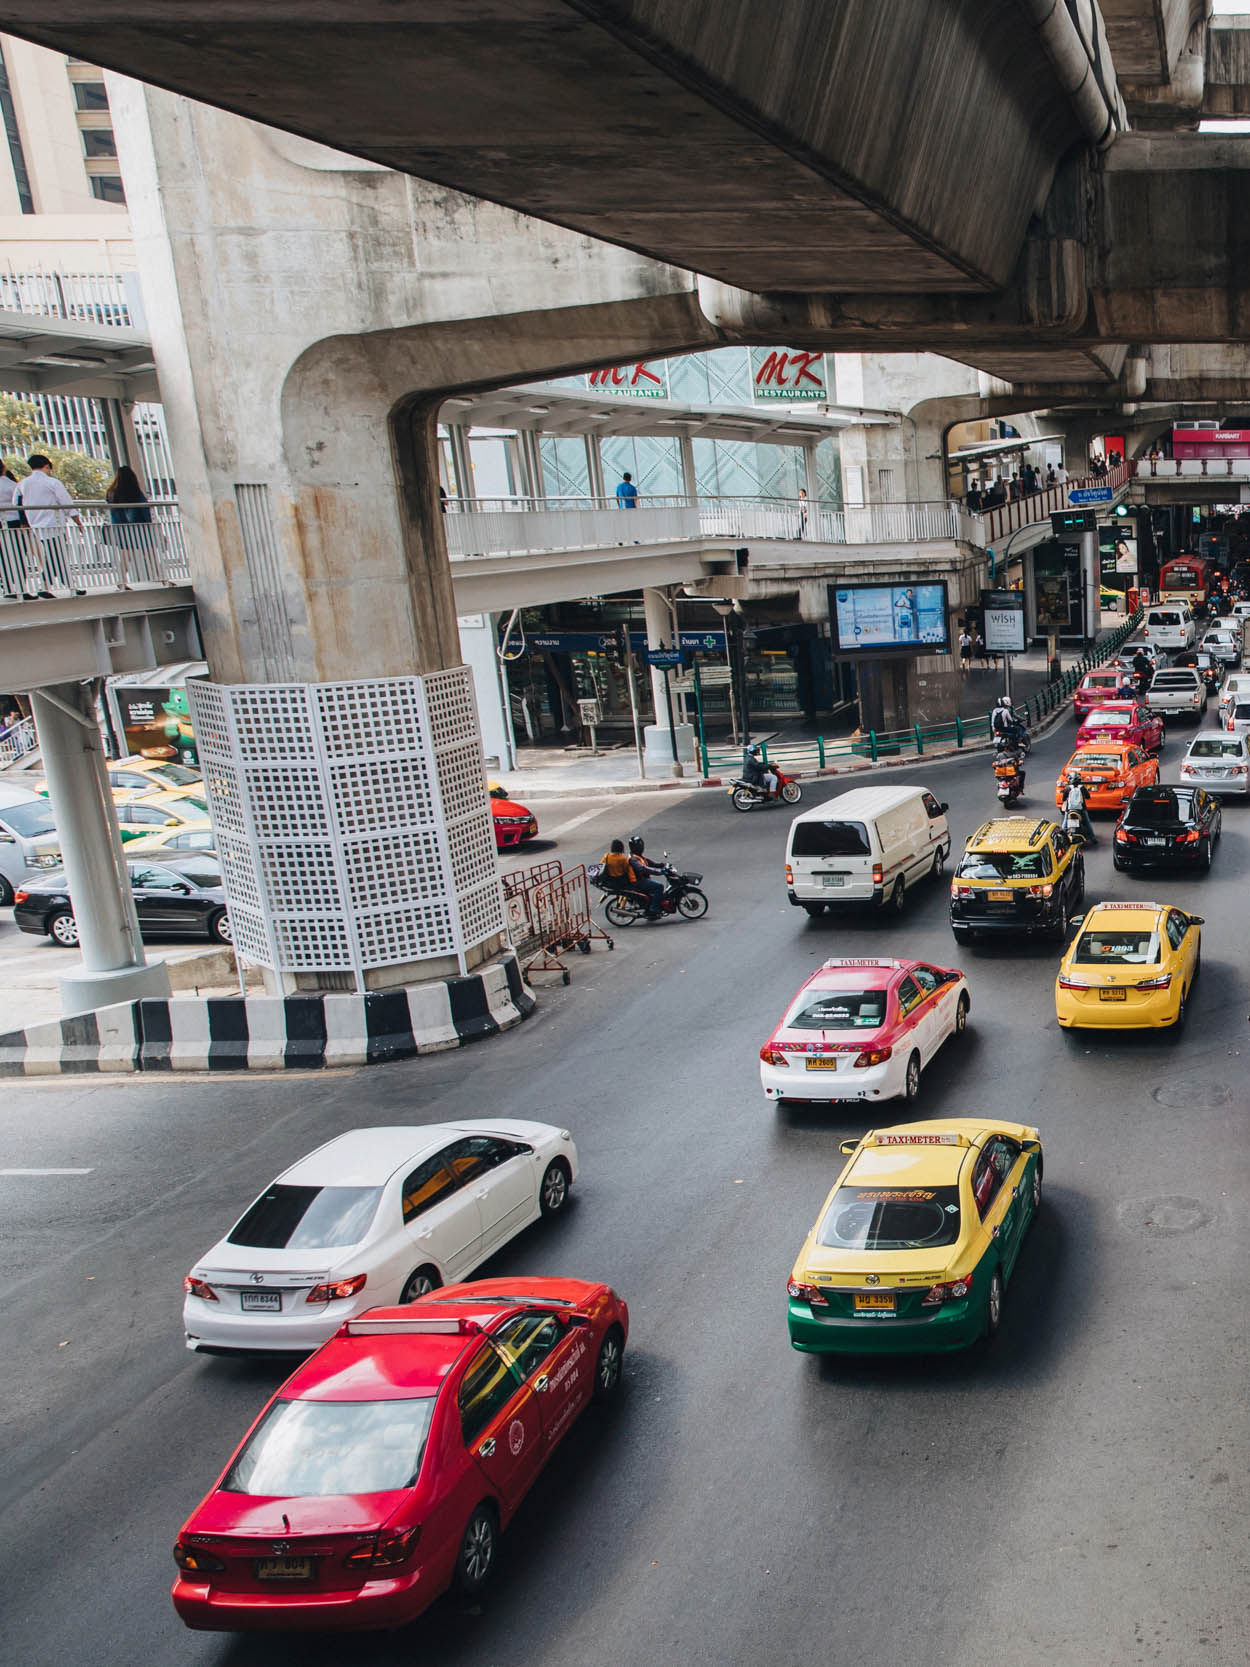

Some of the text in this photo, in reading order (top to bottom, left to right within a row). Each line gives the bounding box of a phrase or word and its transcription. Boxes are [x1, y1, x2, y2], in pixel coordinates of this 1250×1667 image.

[755, 351, 823, 387] MK
[592, 388, 666, 398] ESTAURANTS
[757, 388, 827, 399] RESTAURANTS
[886, 1135, 942, 1145] TAXI-METER
